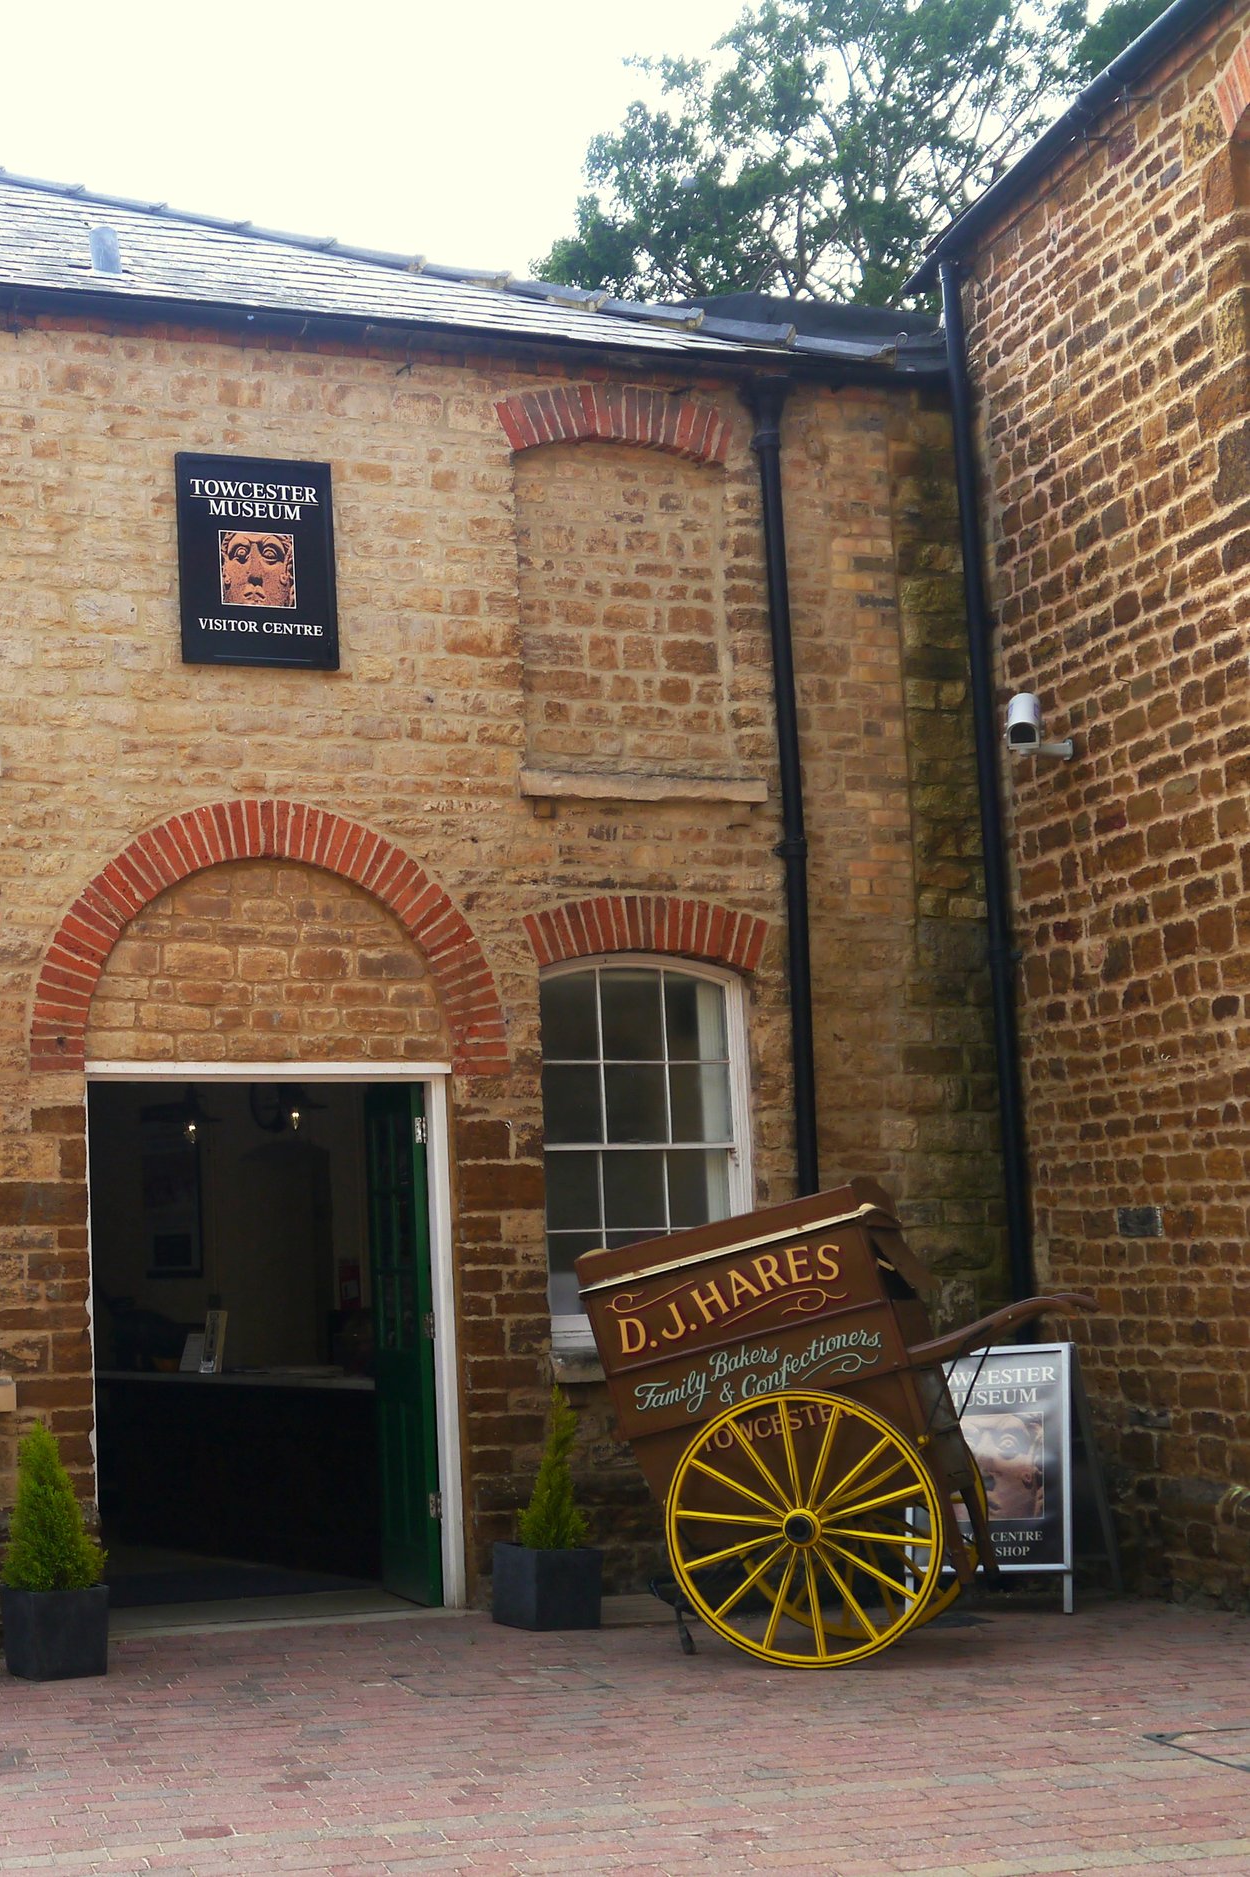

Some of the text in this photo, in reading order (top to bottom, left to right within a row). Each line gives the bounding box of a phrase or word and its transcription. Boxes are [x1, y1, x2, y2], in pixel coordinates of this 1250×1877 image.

[190, 478, 318, 503] TOWCESTER
[208, 499, 302, 521] MUSEUM
[198, 617, 324, 637] VISITOR CENTRE
[634, 1344, 779, 1414] Family Bakers
[945, 1366, 1056, 1387] WCESTER
[719, 1381, 735, 1405] &
[703, 1402, 853, 1453] OWCESTE
[990, 1530, 1043, 1542] CENTRE
[995, 1546, 1030, 1557] SHOP
